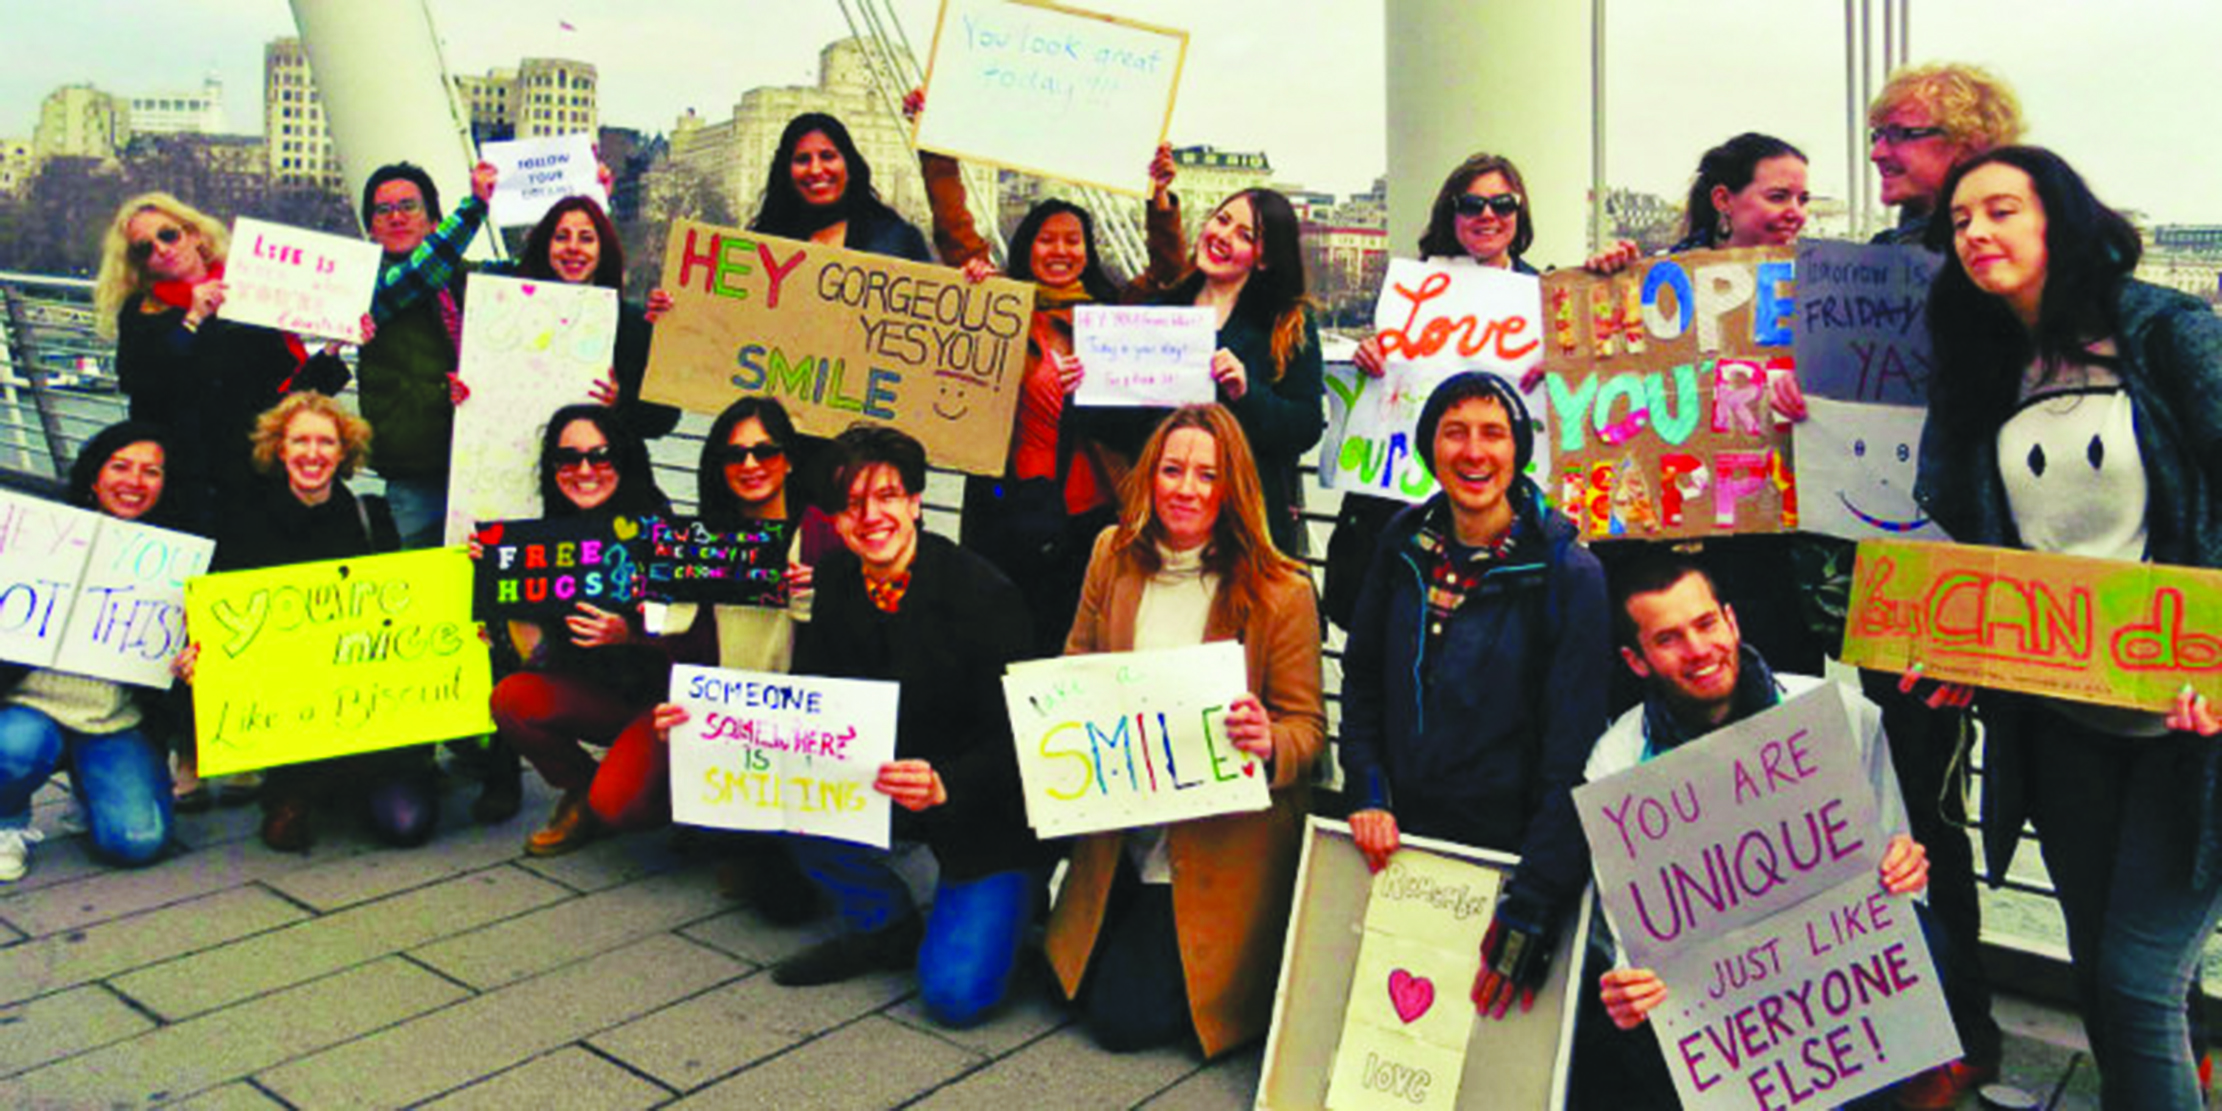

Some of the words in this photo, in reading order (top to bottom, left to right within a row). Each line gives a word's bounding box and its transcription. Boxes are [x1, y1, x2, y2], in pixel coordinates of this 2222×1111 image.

[963, 13, 1007, 50] You
[1021, 24, 1081, 60] look
[1095, 46, 1161, 74] great
[678, 228, 806, 309] HEY
[817, 262, 1023, 340] GORGEOUS
[1377, 271, 1540, 362] Love
[1551, 284, 1578, 356] I
[1590, 258, 1797, 357] HOPE
[1804, 294, 1926, 336] FRIDAY
[730, 344, 902, 420] SMILE
[859, 315, 927, 365] YES
[931, 326, 1009, 392] YOU!
[111, 527, 203, 588] YOU
[497, 541, 603, 569] FREE
[497, 572, 603, 603] HUGS
[333, 618, 464, 666] nice
[1924, 567, 2094, 663] CAN
[209, 700, 279, 752] Like
[688, 675, 823, 714] SOMEONE
[700, 712, 858, 761] SOMEWHERE
[743, 744, 771, 771] IS
[1039, 703, 1239, 801] SMILE
[701, 765, 867, 814] SMILING
[1602, 781, 1701, 860] YOU
[1732, 728, 1819, 805] ARE
[1628, 798, 1864, 943] UNIQUE
[1806, 891, 1895, 957] LIKE
[1678, 942, 1920, 1093] EVERYONE
[1748, 1015, 1888, 1111] ELSE!
